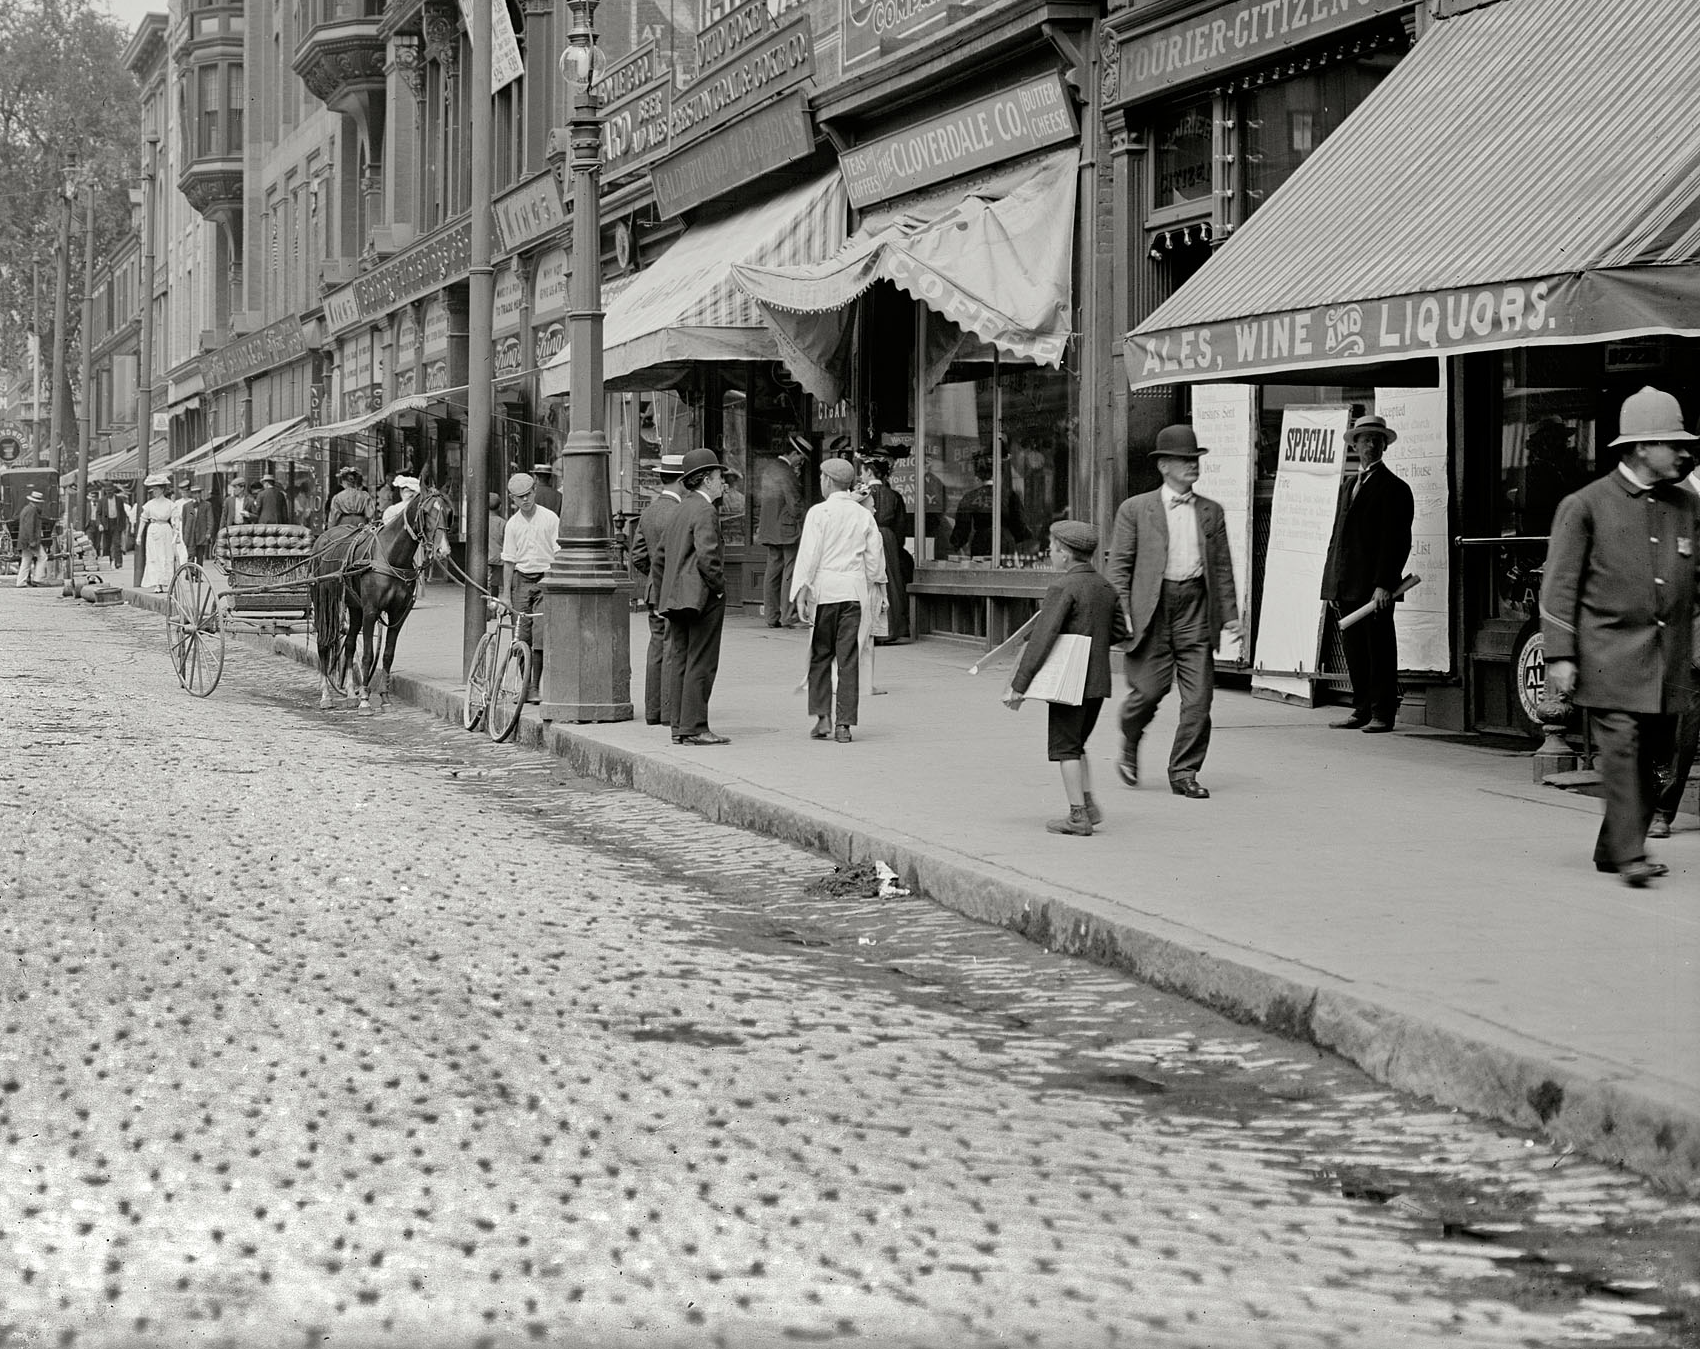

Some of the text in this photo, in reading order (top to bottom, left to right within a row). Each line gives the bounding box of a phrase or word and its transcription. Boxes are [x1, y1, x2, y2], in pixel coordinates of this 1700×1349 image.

[1021, 82, 1058, 113] BUTTER
[891, 111, 995, 178] CLOVERDALE
[994, 100, 1029, 142] CO.
[1030, 108, 1070, 139] CHEESE
[844, 153, 868, 179] TEAS
[887, 253, 1066, 363] COFFEE
[1141, 280, 1556, 375] ALES, WINE AND LIQUORS.
[1379, 402, 1406, 419] Accepted
[1285, 427, 1335, 464] SPECIAL
[1412, 462, 1432, 477] House
[1416, 540, 1432, 556] List
